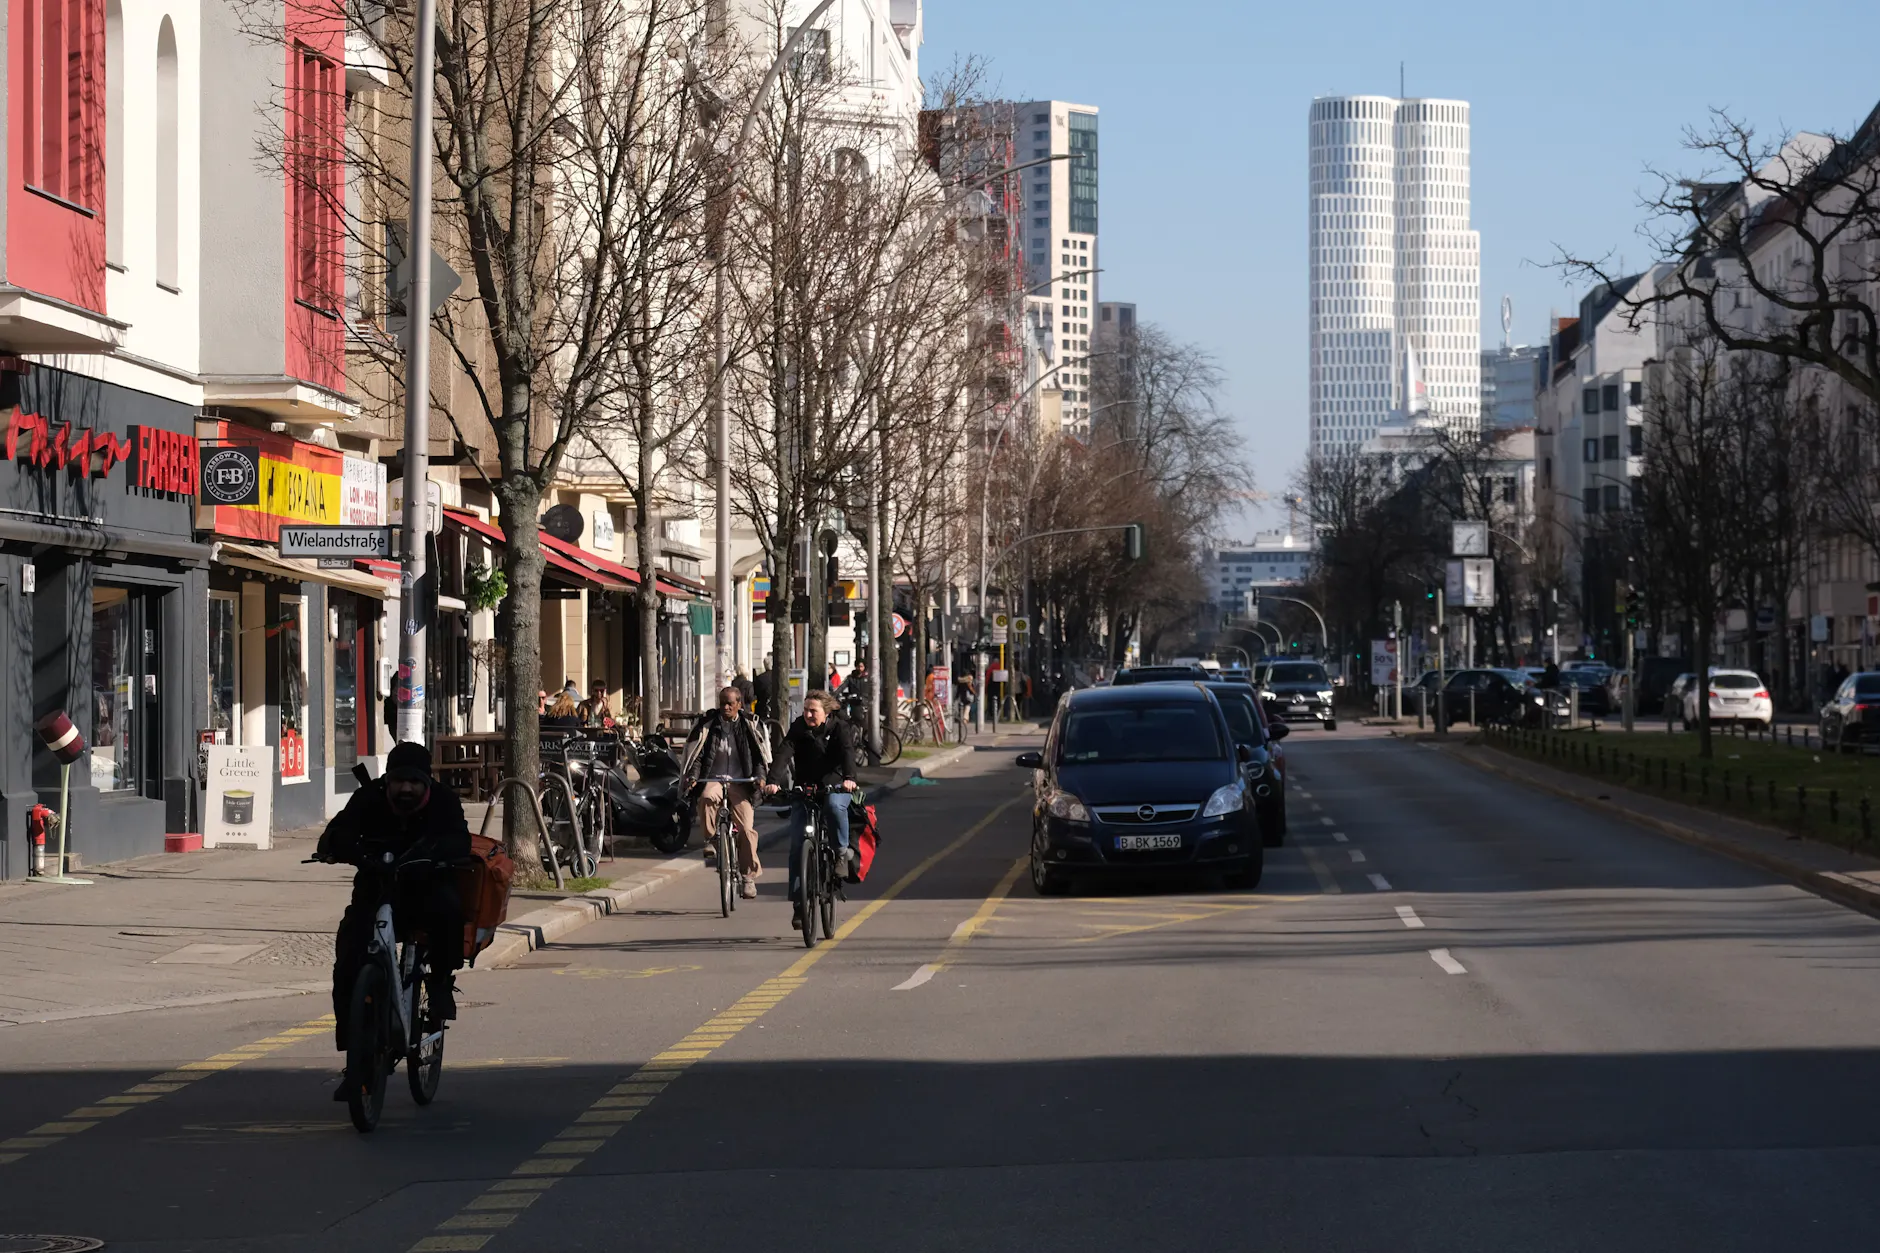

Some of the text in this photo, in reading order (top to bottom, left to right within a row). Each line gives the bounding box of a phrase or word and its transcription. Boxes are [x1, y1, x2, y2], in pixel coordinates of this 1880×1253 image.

[136, 424, 199, 496] FARBEN
[207, 452, 232, 474] FARROW
[240, 456, 253, 473] BALL
[216, 468, 244, 485] F&B
[208, 482, 225, 498] PAINT
[235, 481, 252, 498] PAPER
[289, 469, 327, 520] ESPAÑA
[288, 532, 385, 551] Wielandstraße
[323, 559, 333, 567] 50
[339, 559, 348, 567] 45
[226, 758, 255, 768] Little
[219, 767, 261, 778] Greene
[1121, 836, 1180, 849] B BK 1569
